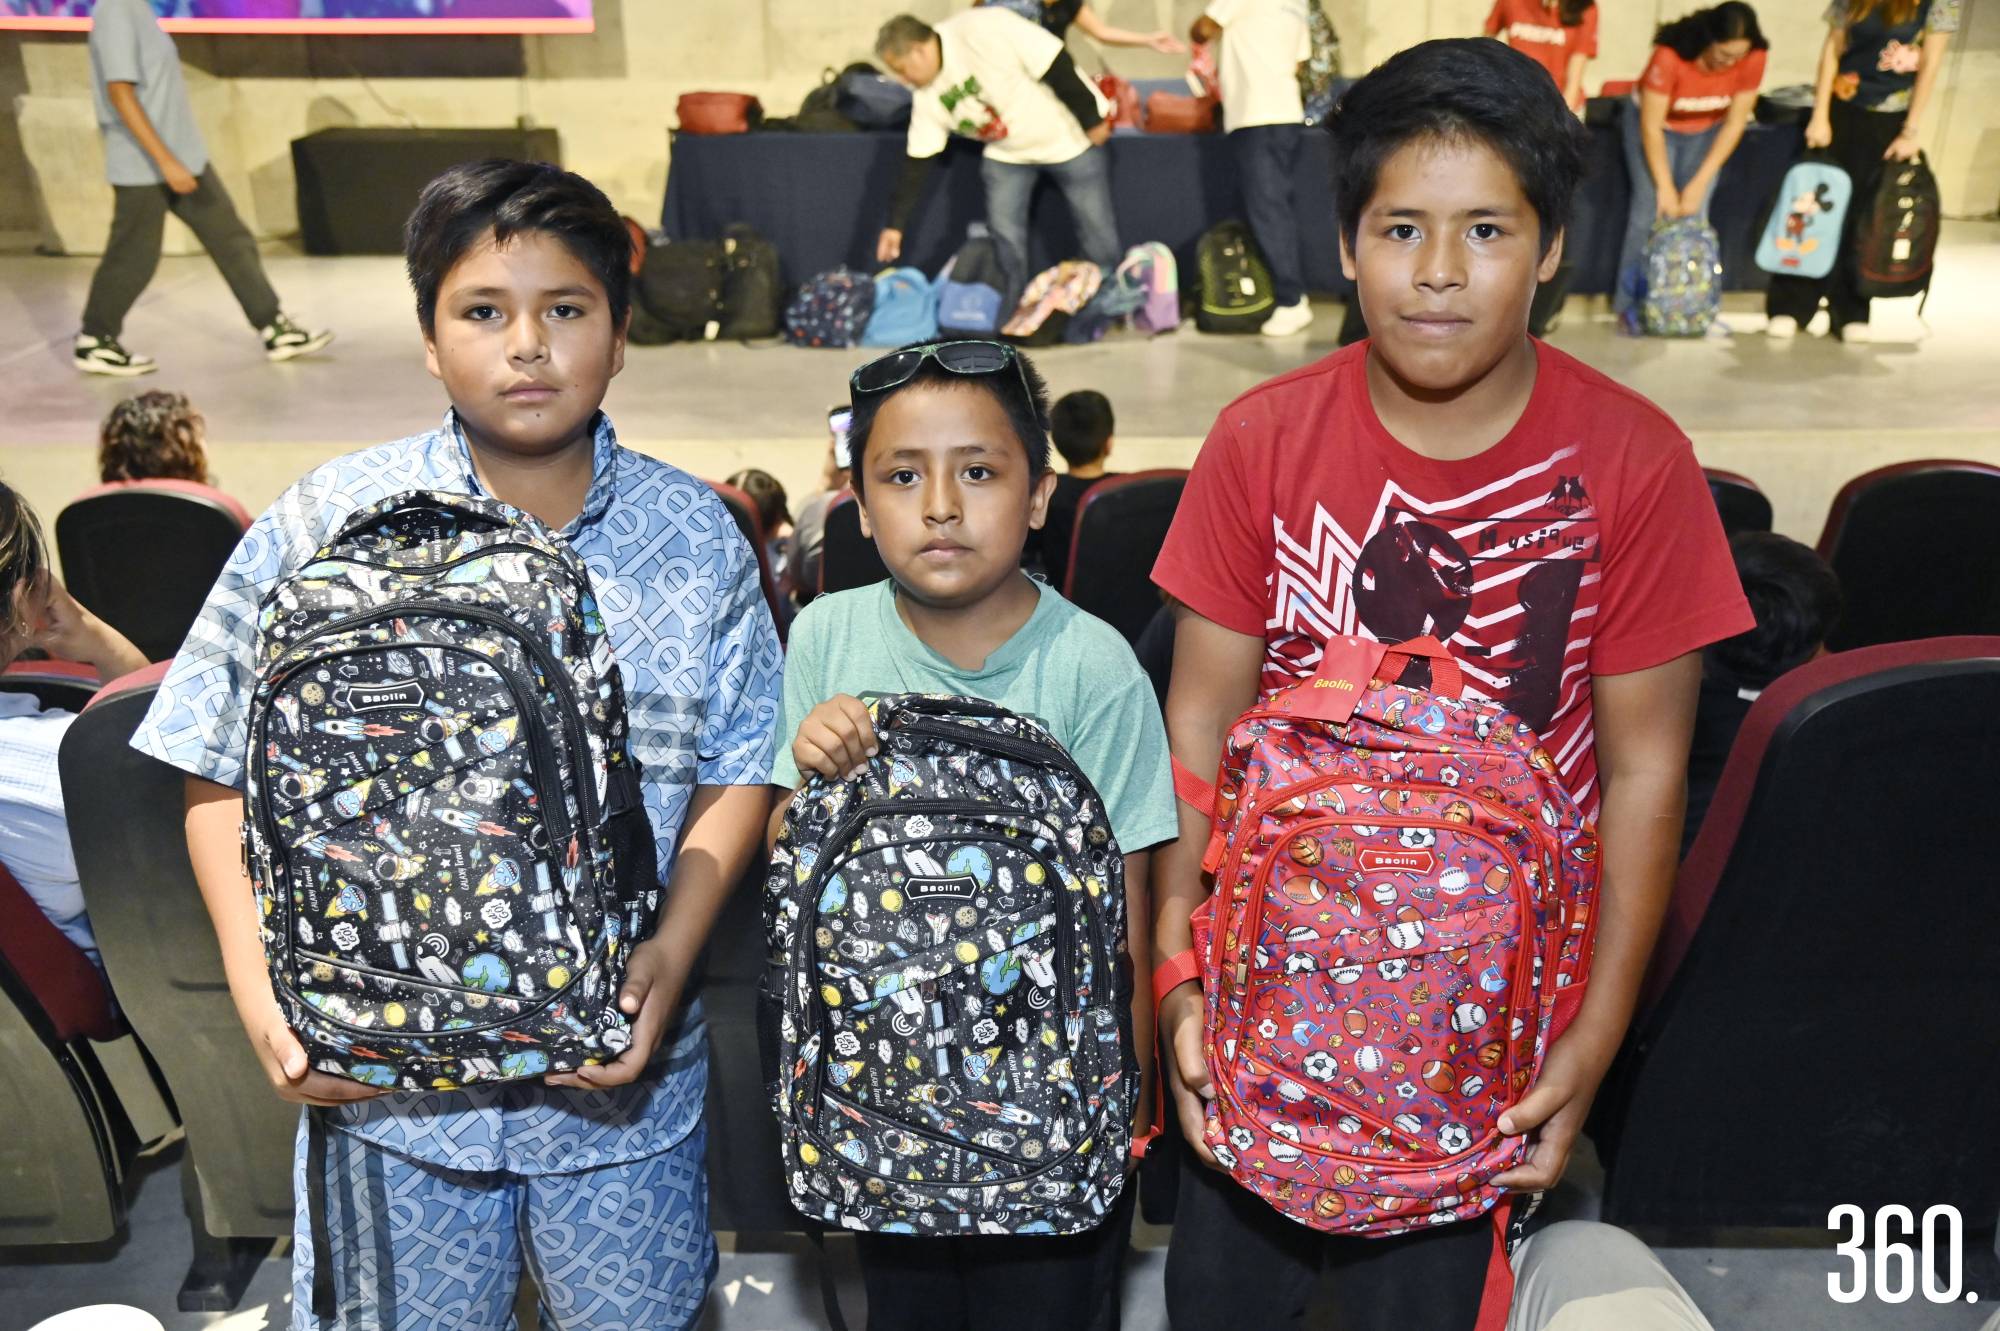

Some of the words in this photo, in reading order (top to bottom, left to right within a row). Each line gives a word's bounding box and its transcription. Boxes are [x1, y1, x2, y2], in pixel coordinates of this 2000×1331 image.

[1314, 679, 1355, 692] Baolin
[361, 693, 407, 703] Baolin
[450, 844, 464, 866] Travel
[1375, 857, 1417, 866] Baolin
[301, 865, 314, 888] Travel
[920, 884, 961, 893] Baolin
[1012, 1072, 1025, 1093] Travel
[873, 1088, 886, 1107] Travel
